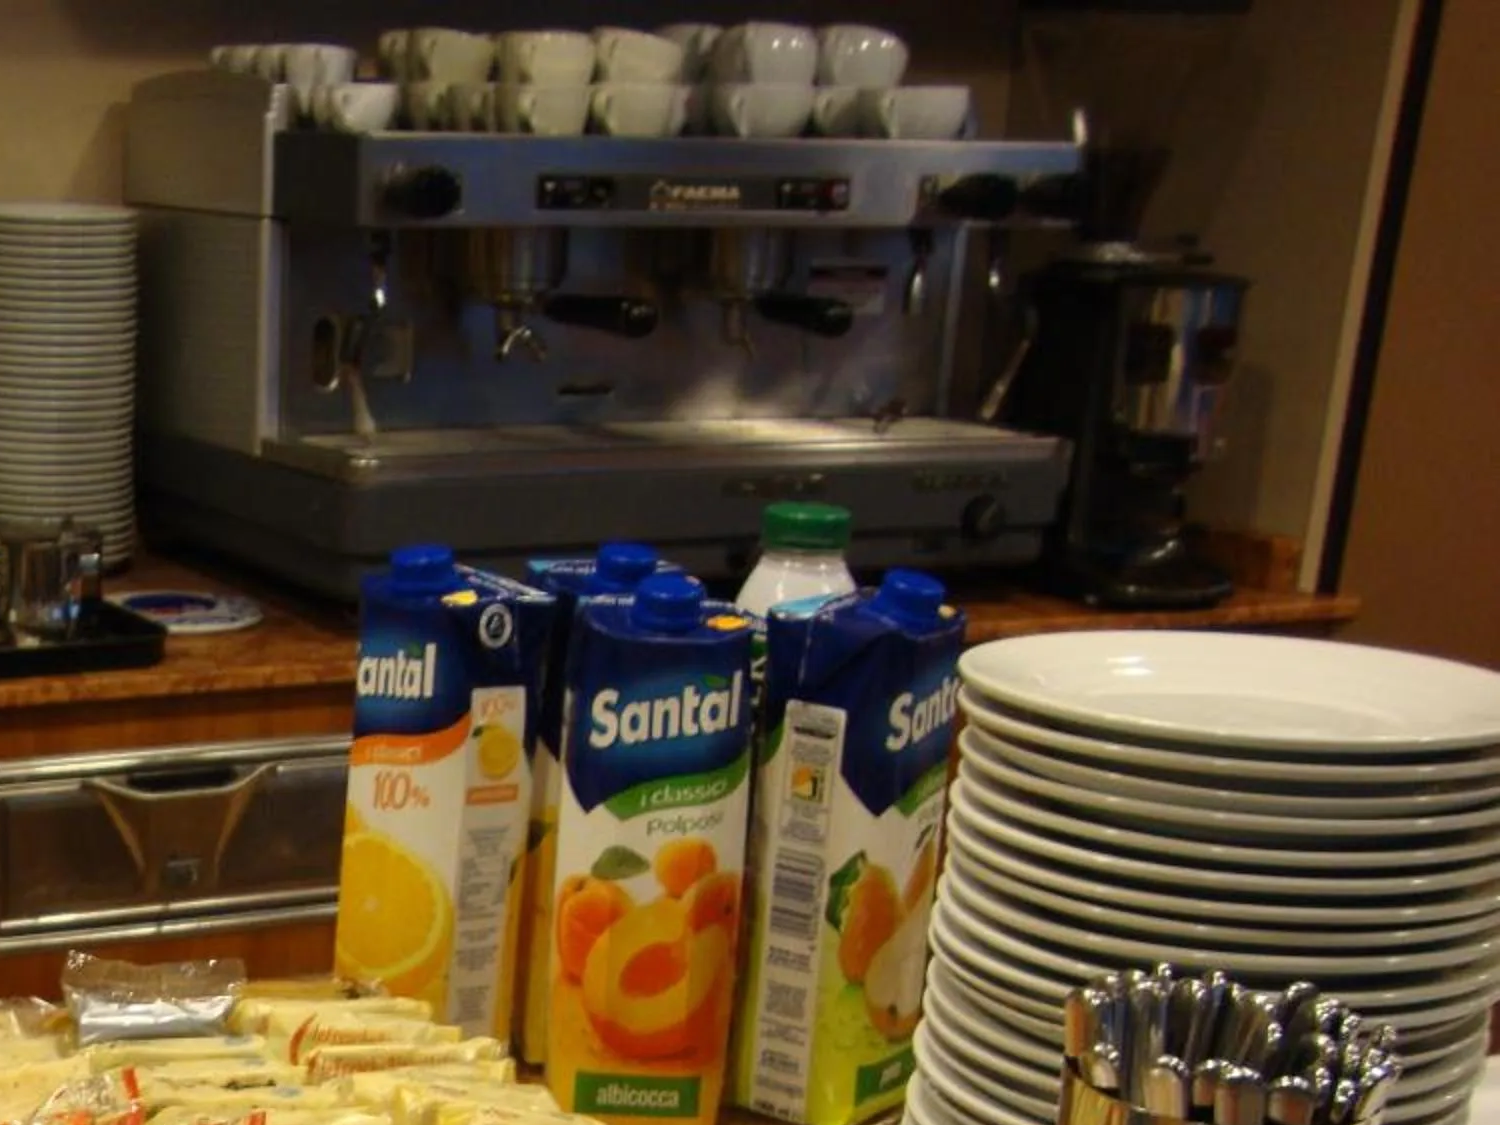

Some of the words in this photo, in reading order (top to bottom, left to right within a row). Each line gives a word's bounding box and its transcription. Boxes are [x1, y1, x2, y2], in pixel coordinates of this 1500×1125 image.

[356, 641, 438, 699] antal
[885, 676, 960, 751] Sant
[373, 768, 432, 810] 100%
[596, 1083, 680, 1108] albicocca
